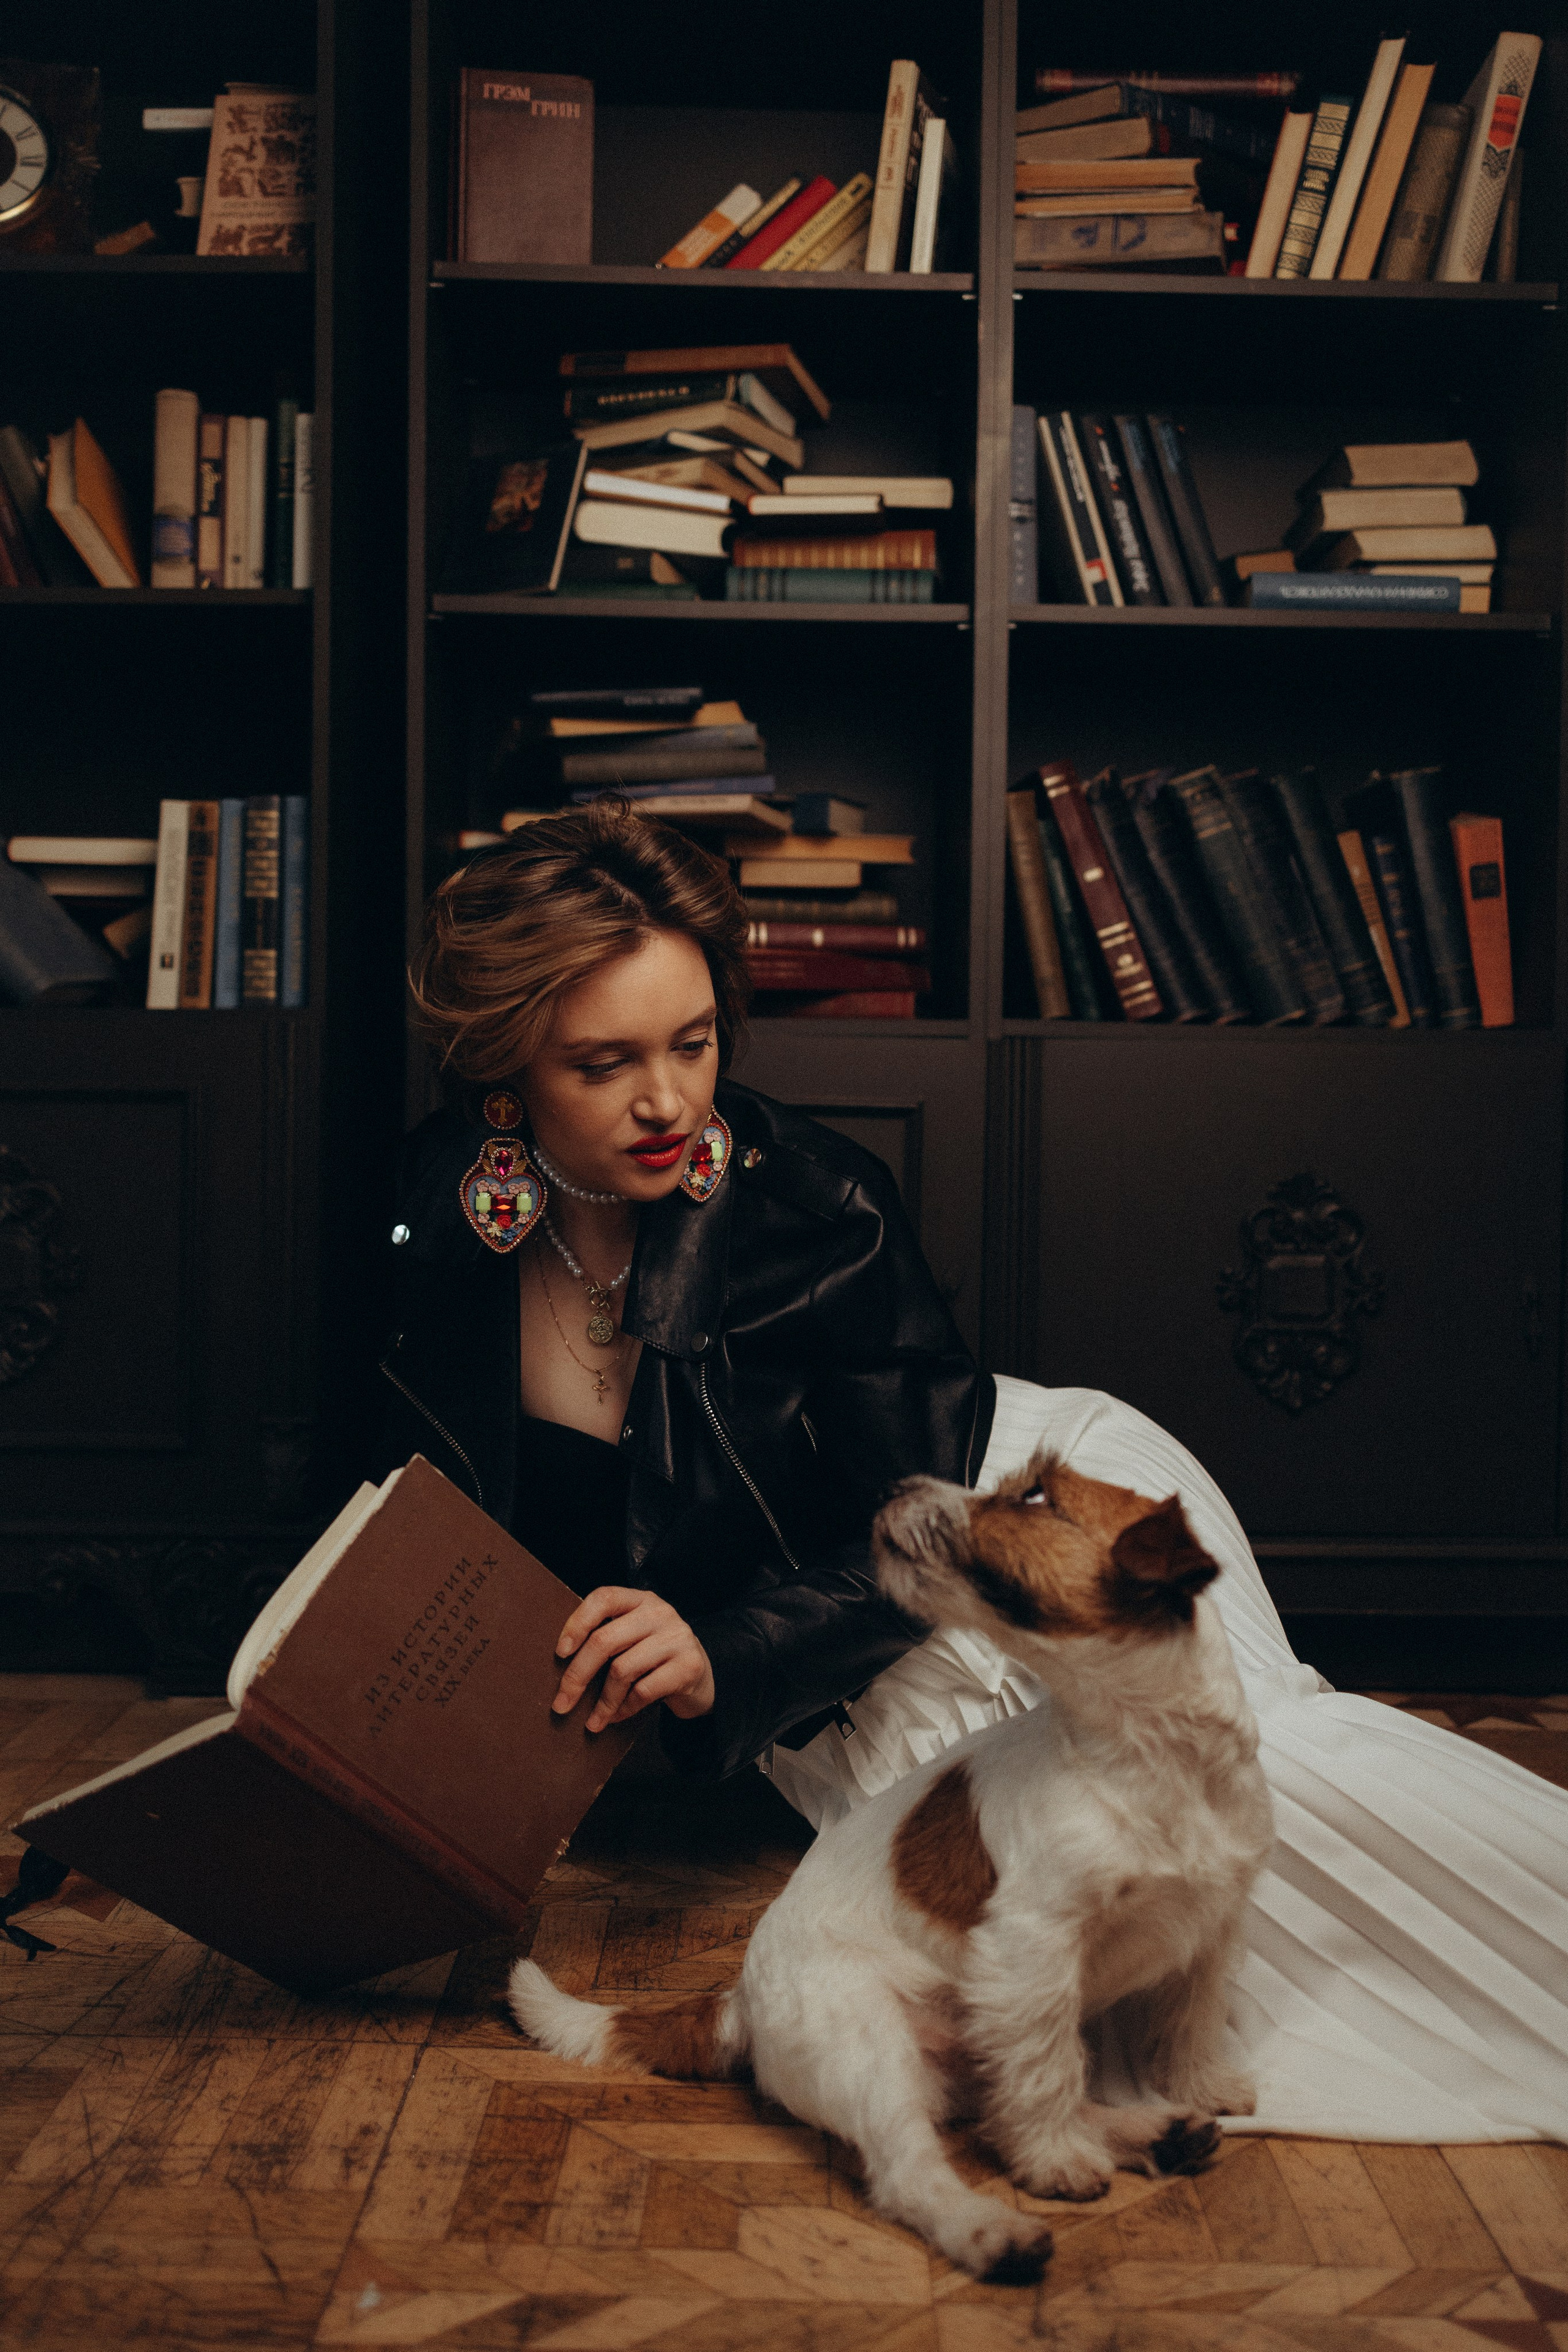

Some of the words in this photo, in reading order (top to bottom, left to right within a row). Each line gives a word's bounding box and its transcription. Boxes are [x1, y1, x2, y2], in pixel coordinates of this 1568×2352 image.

[483, 82, 530, 102] ГРЭМ
[531, 99, 581, 119] ГРИН
[364, 1672, 391, 1705] ИЗ
[390, 1556, 472, 1667] ИСТОРИИ
[369, 1553, 499, 1740] ЛИТЕРАТУРНЫХ
[434, 1674, 461, 1709] XIX
[460, 1638, 491, 1676] ВЕКА
